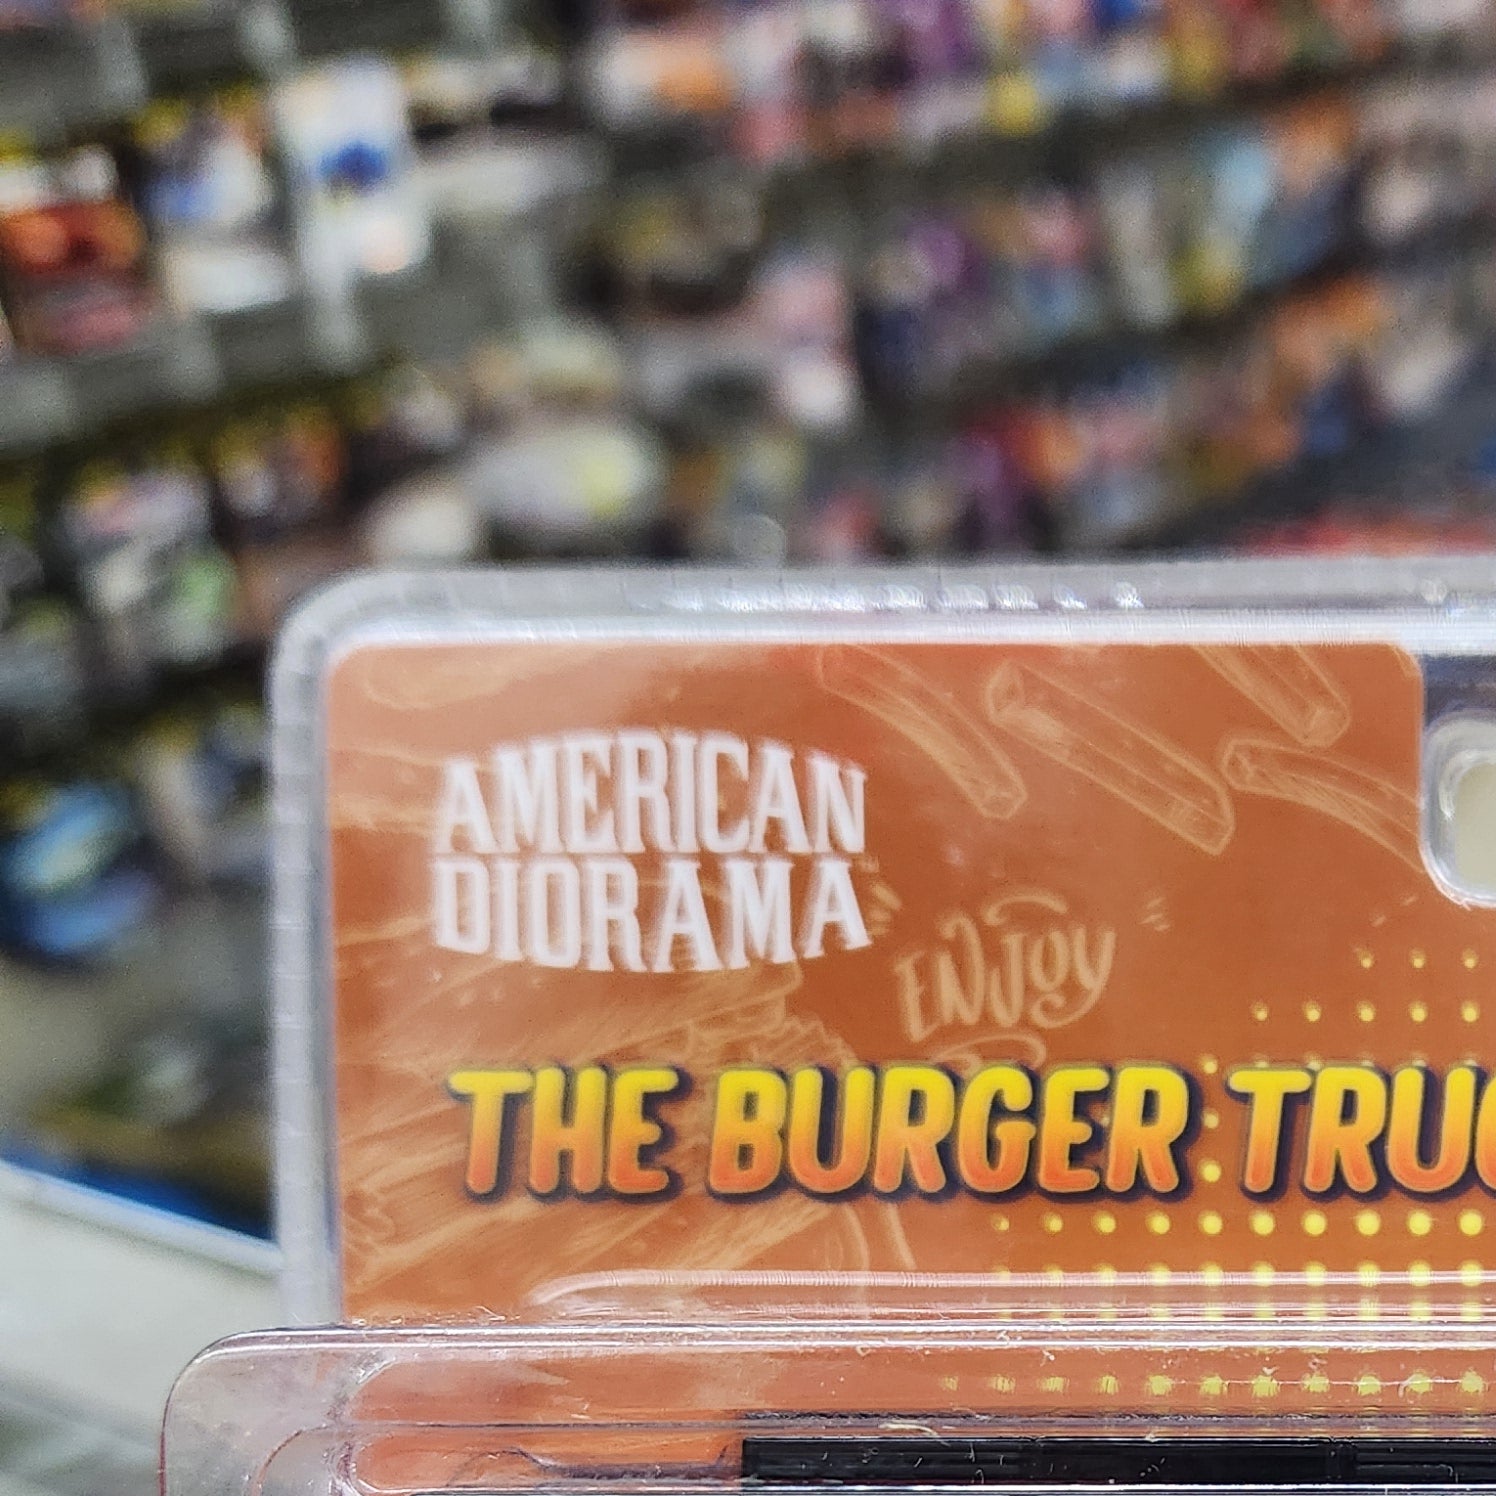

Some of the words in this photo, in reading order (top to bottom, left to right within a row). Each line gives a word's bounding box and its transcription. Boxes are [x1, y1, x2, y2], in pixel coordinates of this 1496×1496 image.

[436, 728, 868, 854] AMERICAN
[434, 856, 874, 974] DIORAMA
[447, 1066, 685, 1204] THE
[707, 1064, 1196, 1204] BURGER
